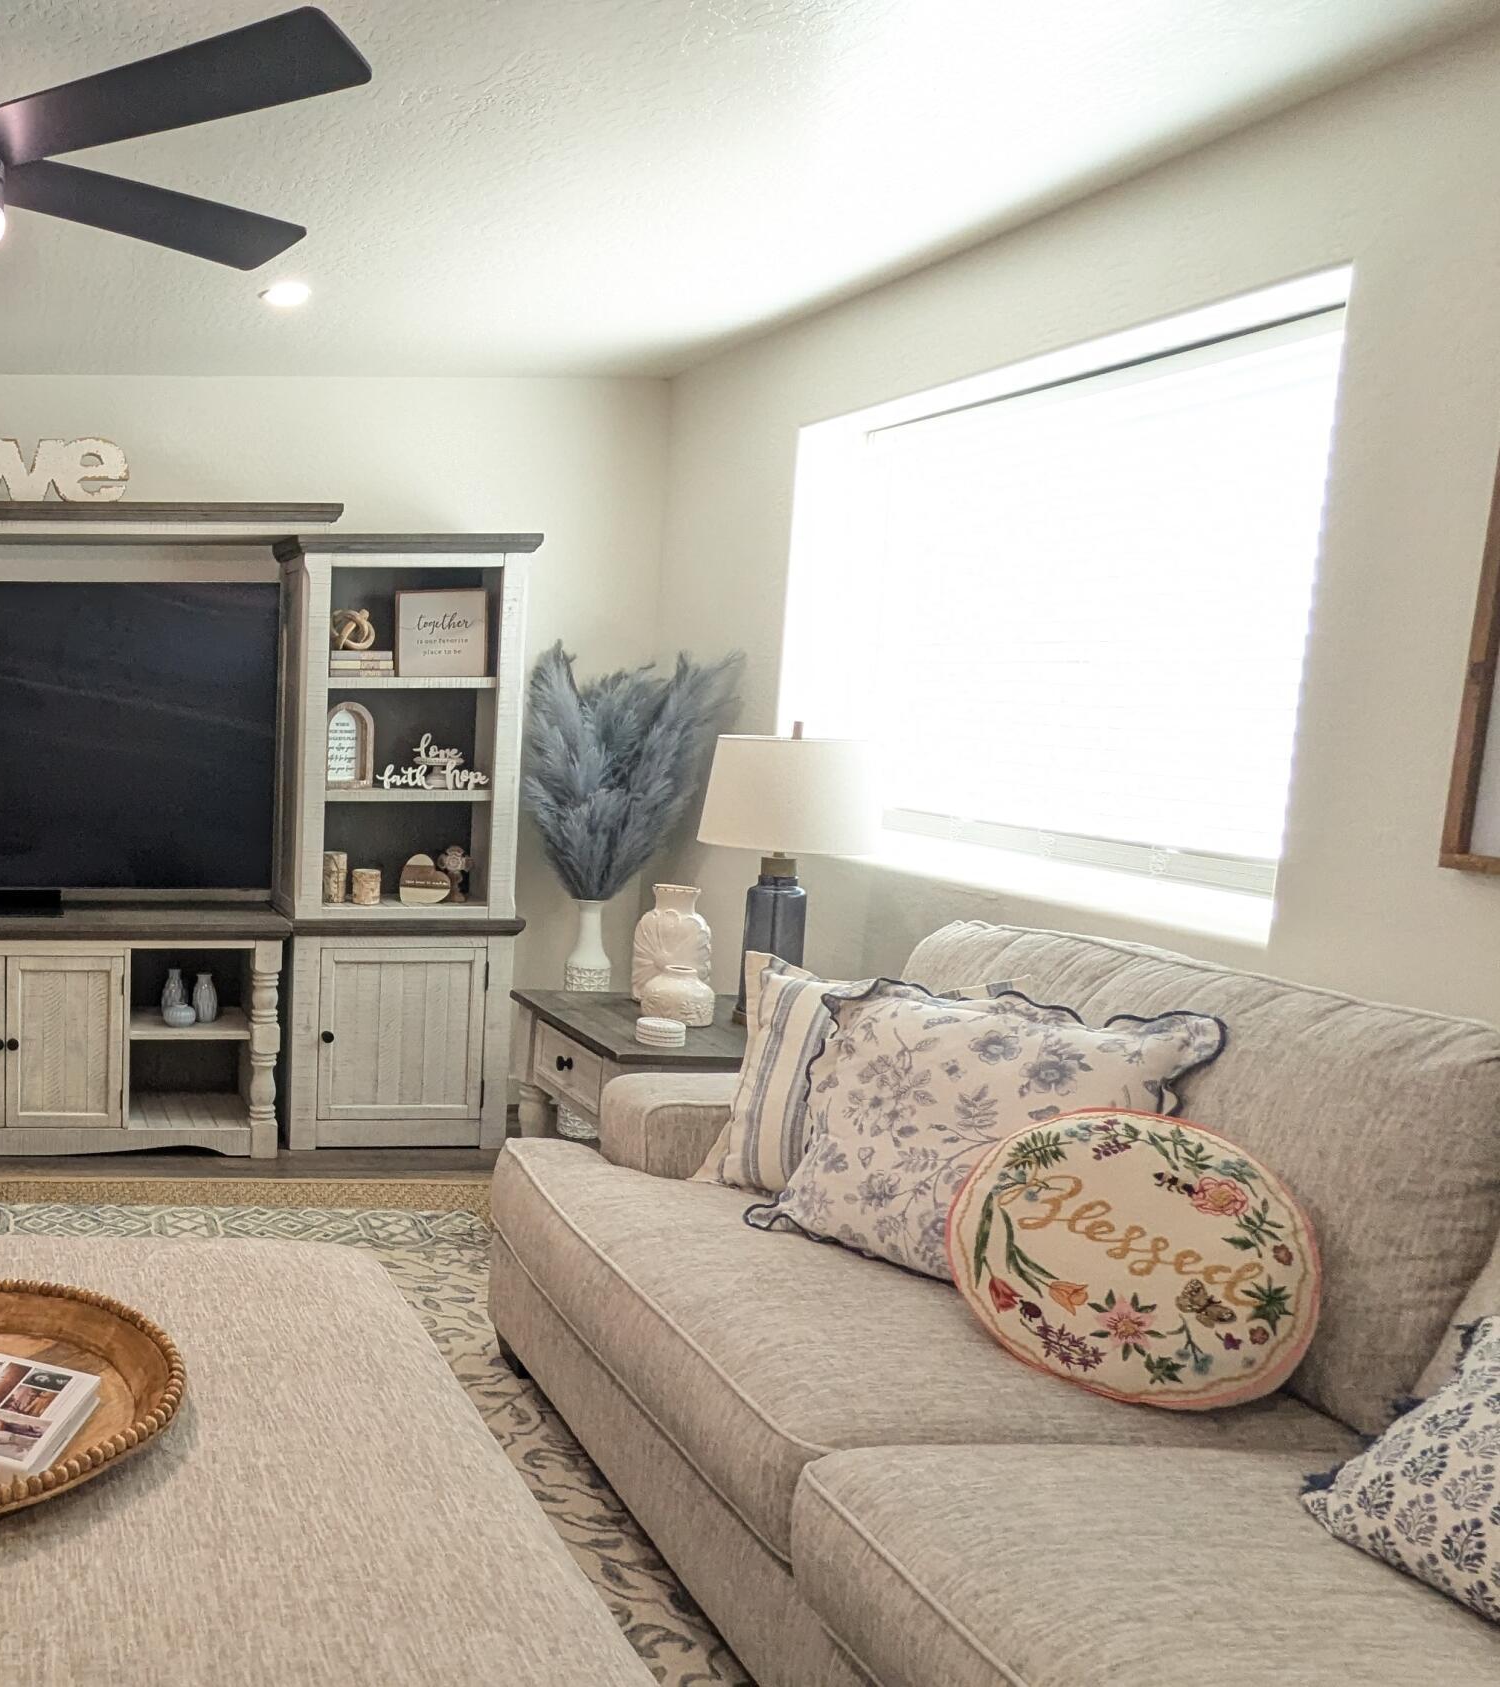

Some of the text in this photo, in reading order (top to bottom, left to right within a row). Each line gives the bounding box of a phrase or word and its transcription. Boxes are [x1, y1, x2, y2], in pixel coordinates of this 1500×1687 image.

[416, 611, 470, 634] together
[412, 732, 463, 759] love
[375, 760, 490, 790] faith hope
